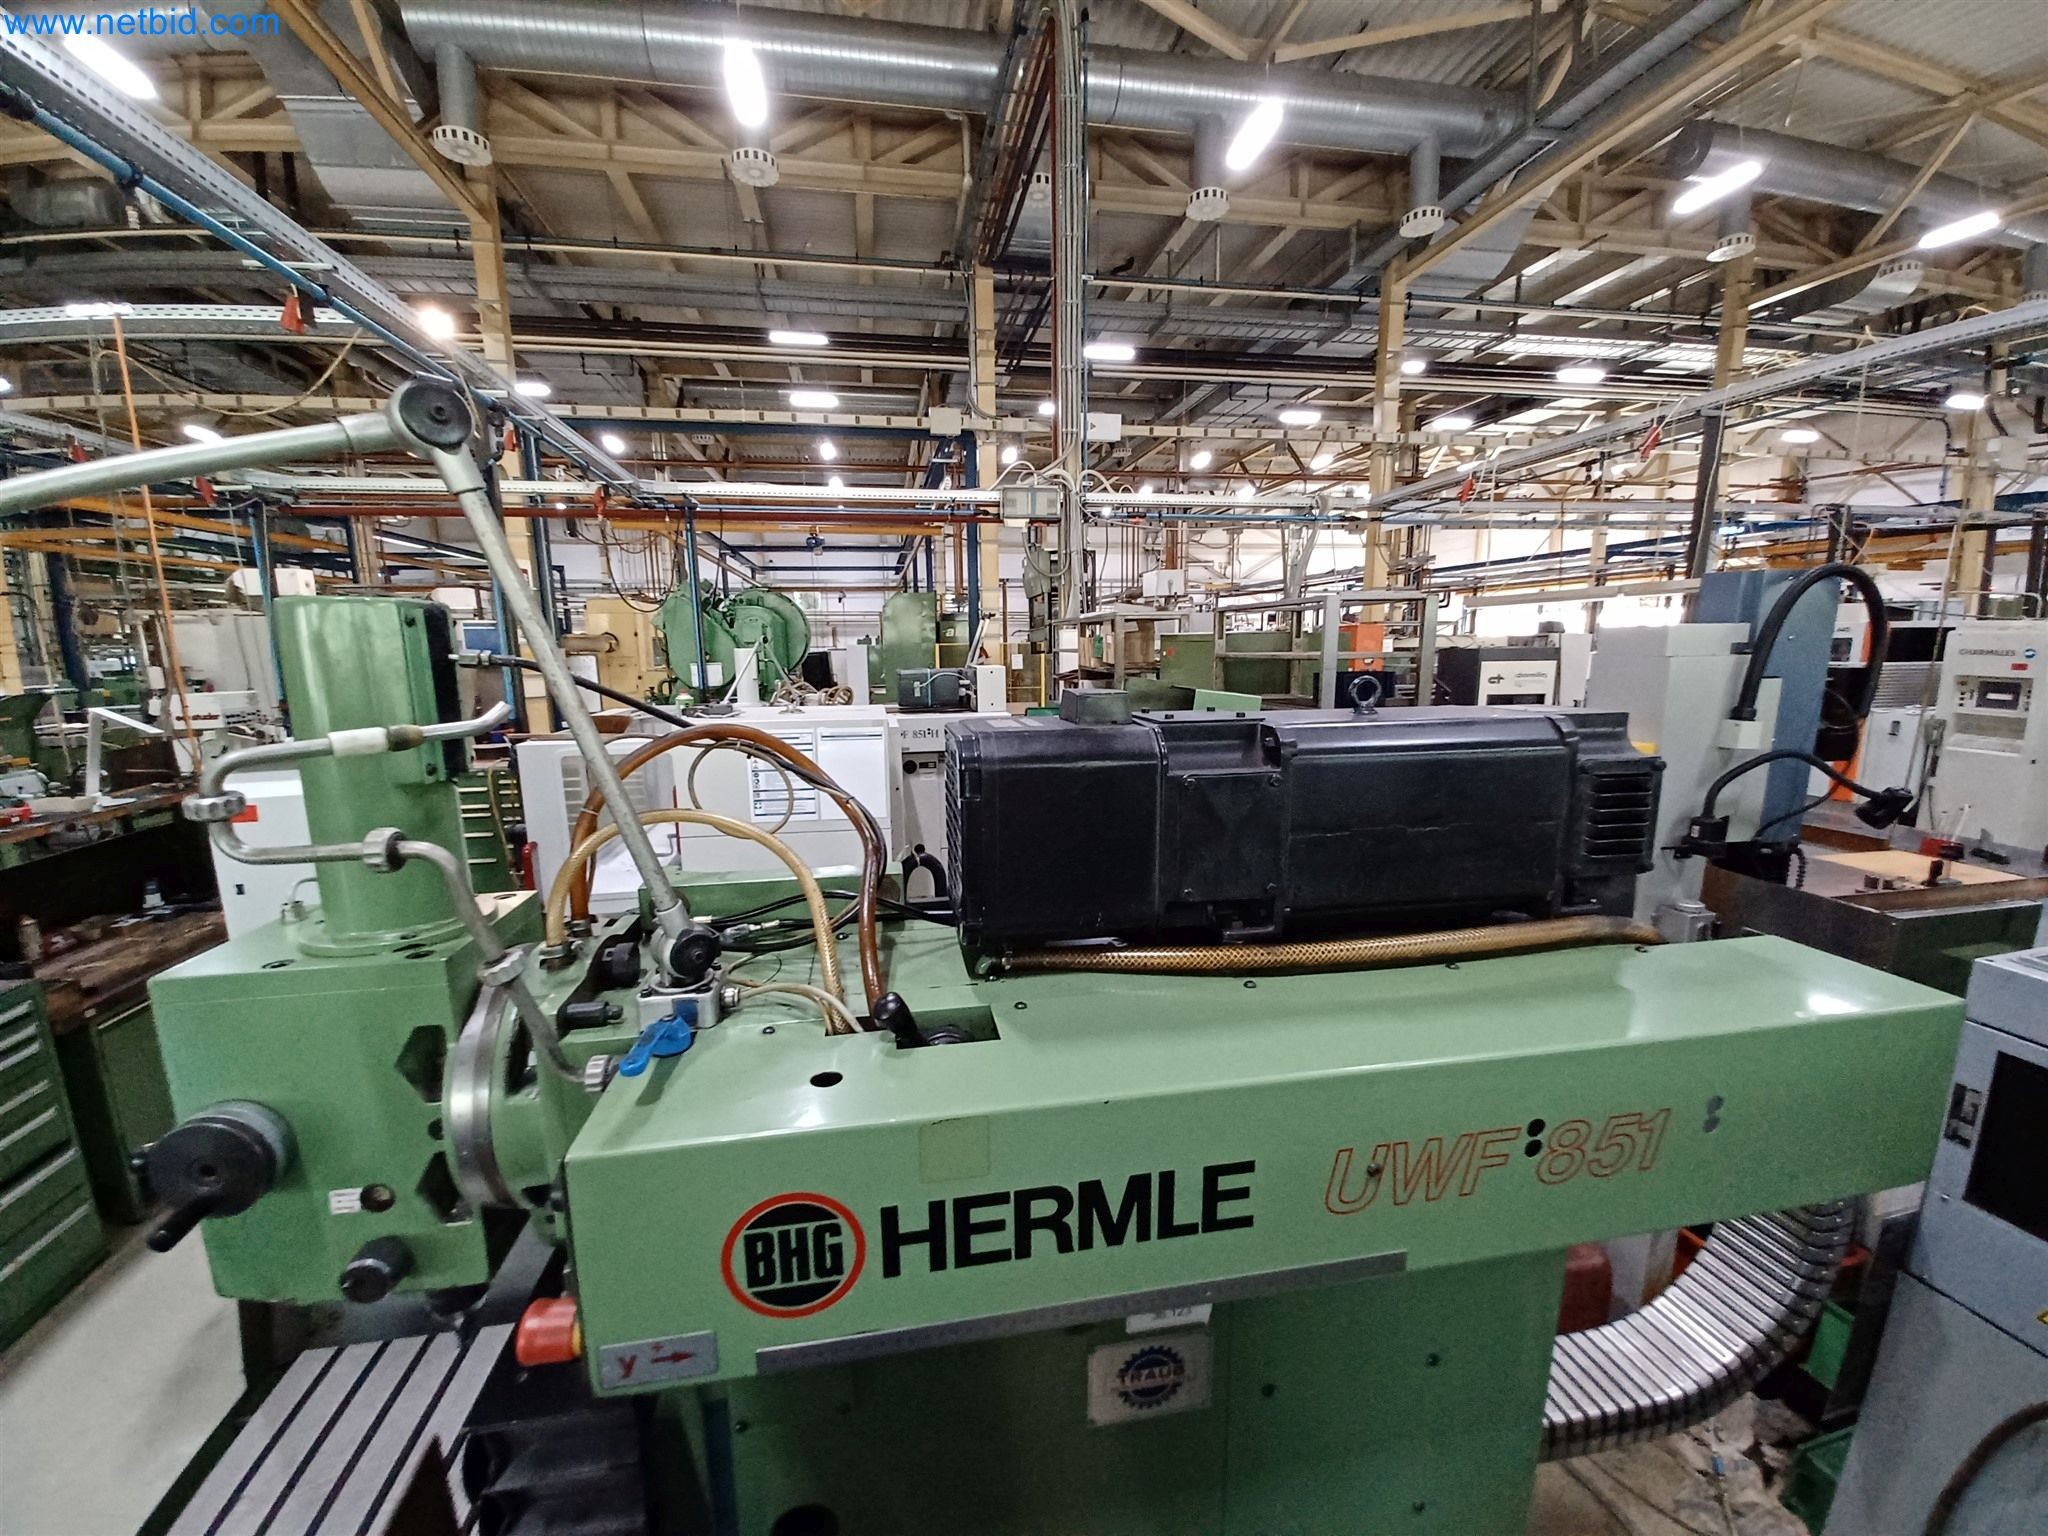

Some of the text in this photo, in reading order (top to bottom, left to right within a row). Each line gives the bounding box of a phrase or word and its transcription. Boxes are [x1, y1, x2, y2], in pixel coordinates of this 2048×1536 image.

[1324, 1108, 1672, 1215] UWF 851
[743, 1159, 1256, 1289] BHG HERMLE
[1118, 1363, 1186, 1385] TRAUB
